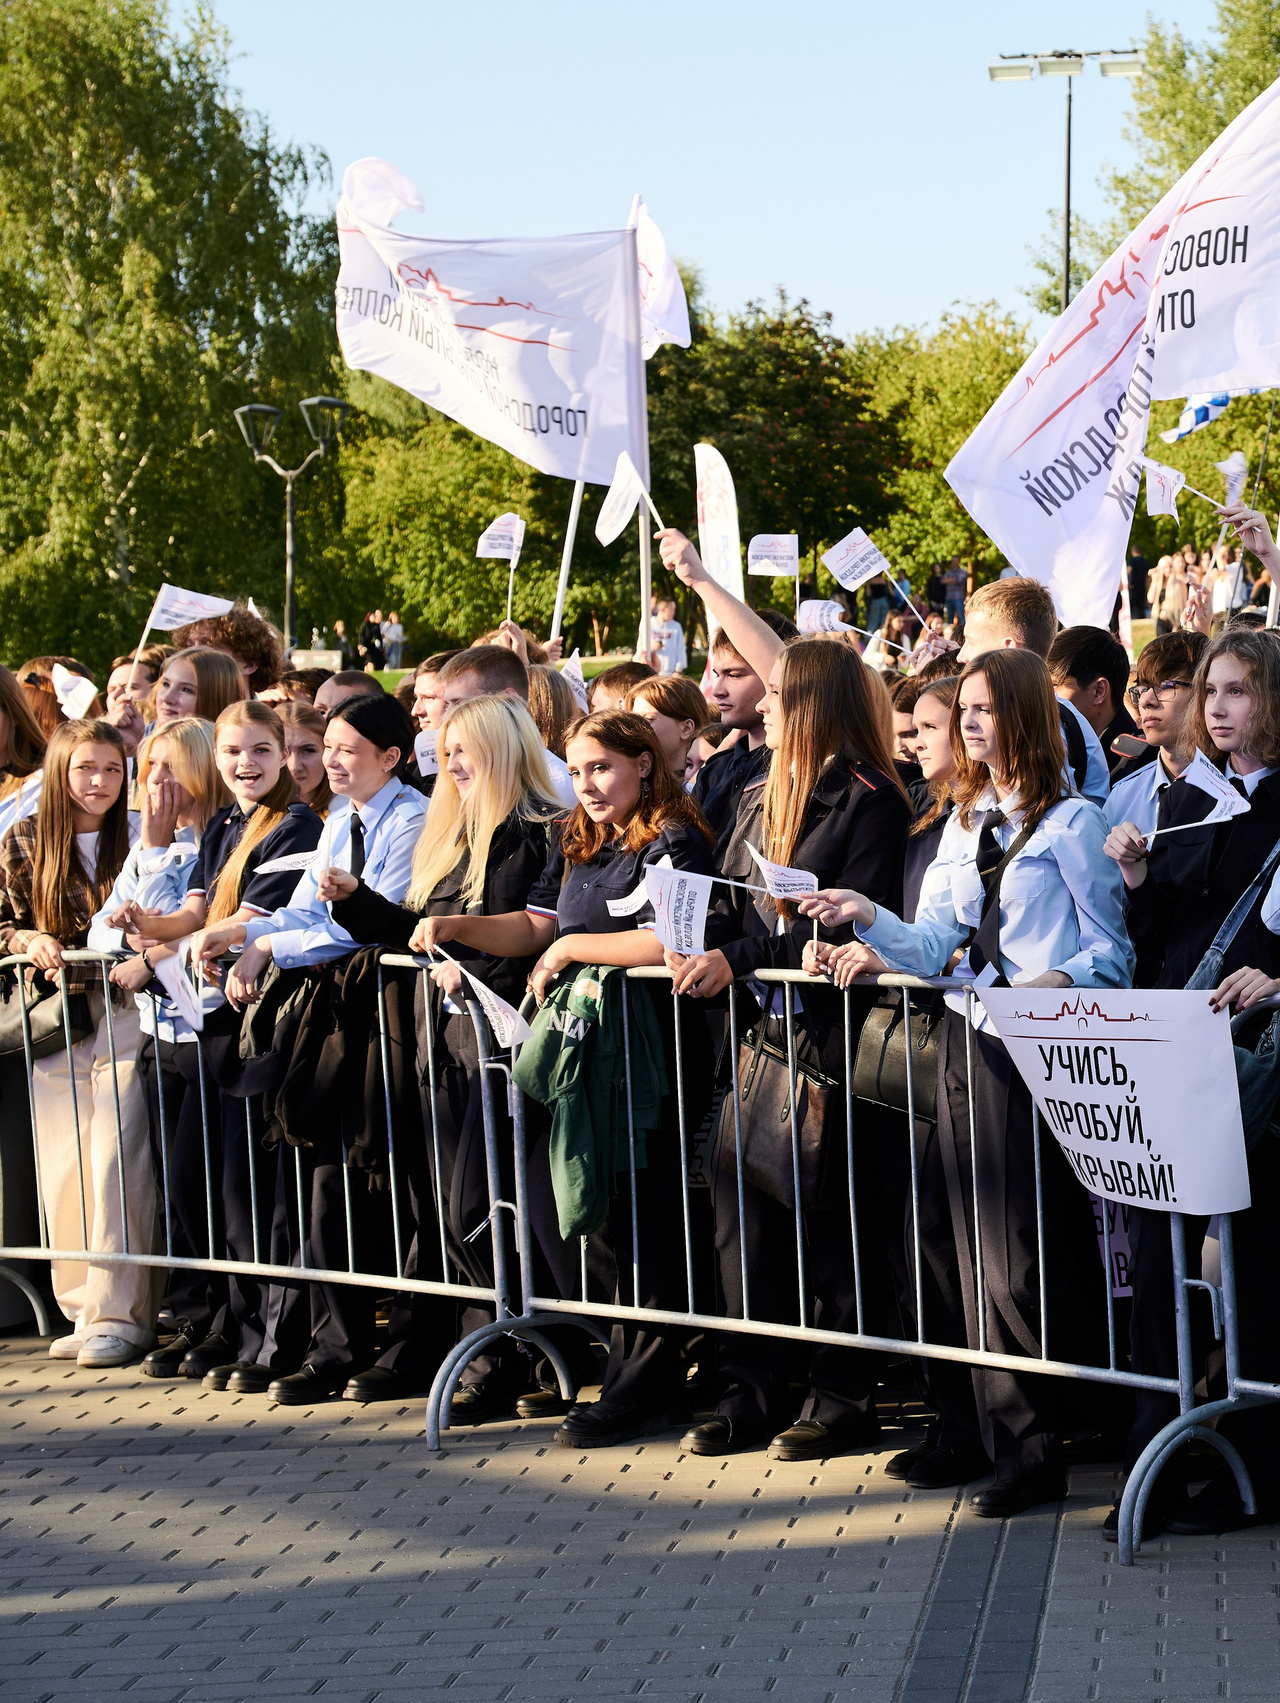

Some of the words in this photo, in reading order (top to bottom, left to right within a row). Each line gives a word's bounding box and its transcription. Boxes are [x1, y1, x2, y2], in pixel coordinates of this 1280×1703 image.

[1038, 1044, 1136, 1093] УЧИСЬ,
[1044, 1095, 1152, 1151] ПРОБУЙ,
[1060, 1144, 1178, 1203] ТКРЫВАЙ!
